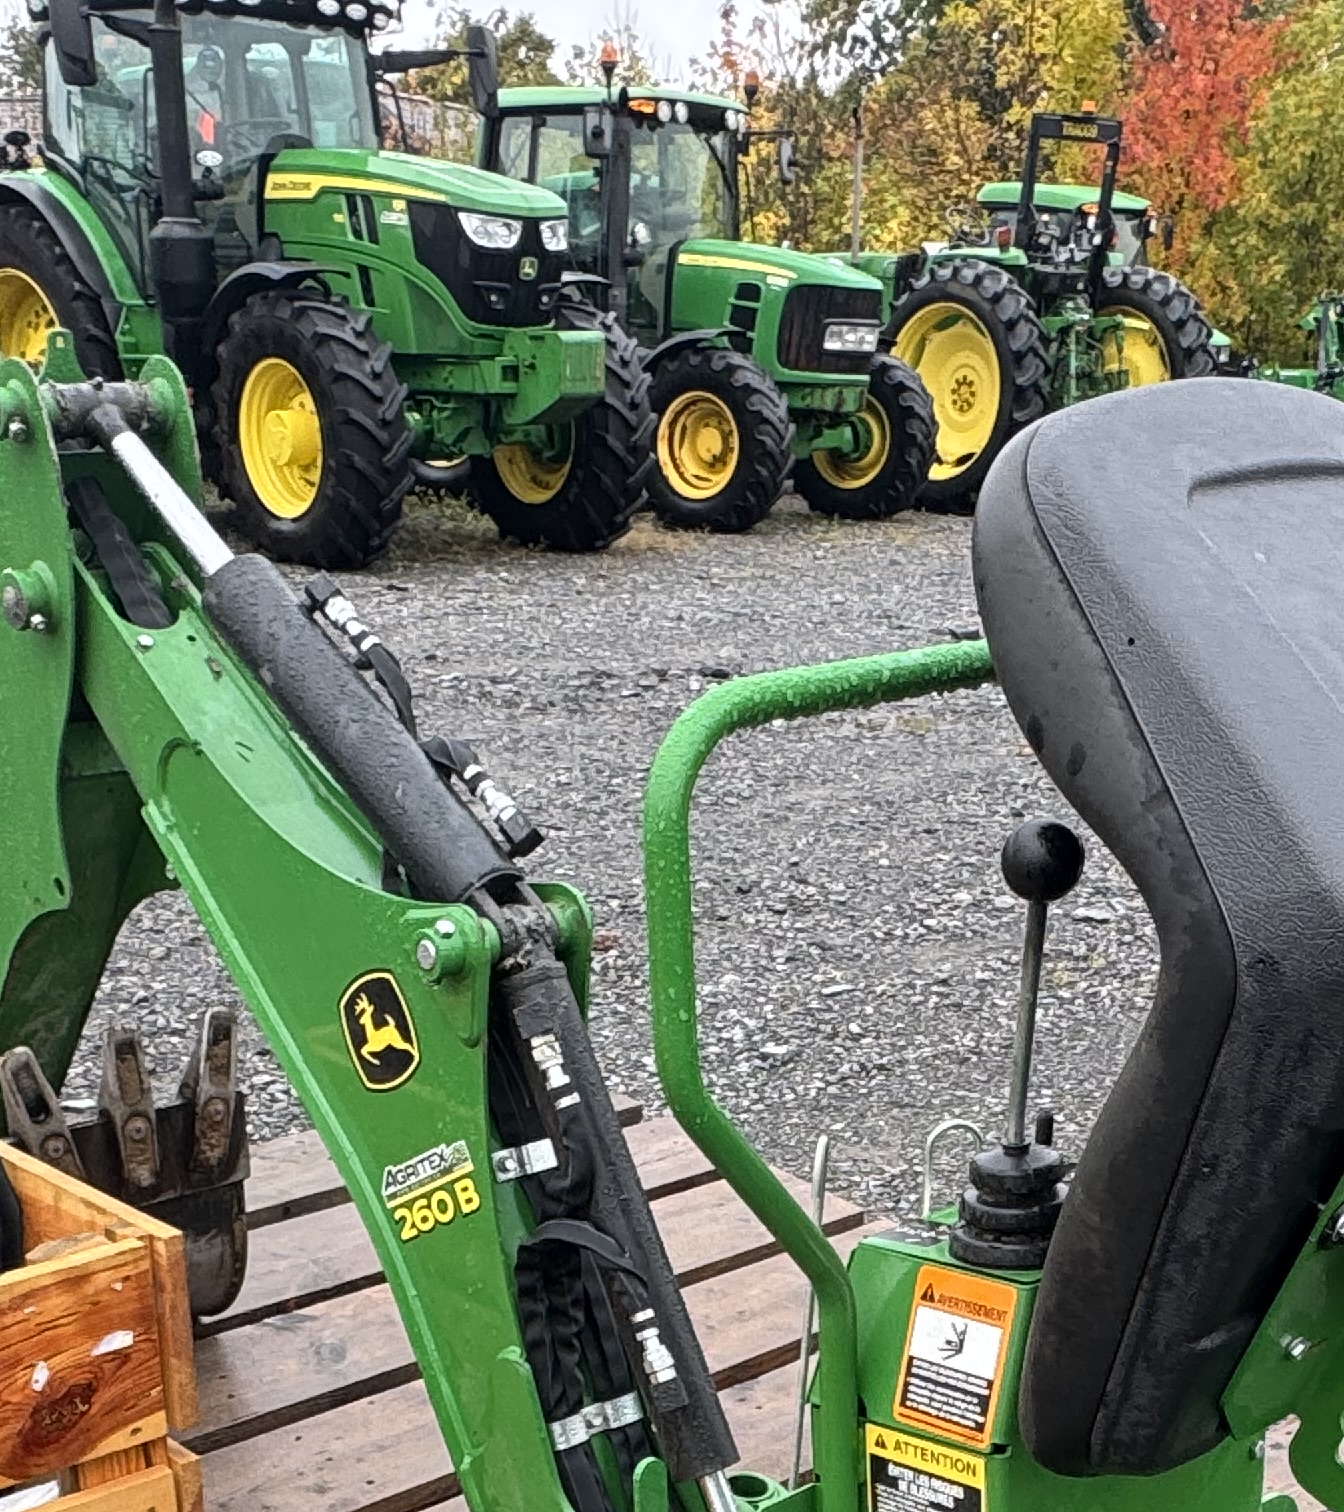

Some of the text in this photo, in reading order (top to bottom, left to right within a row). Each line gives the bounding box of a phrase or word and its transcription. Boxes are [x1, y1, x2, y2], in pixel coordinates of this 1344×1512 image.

[384, 1148, 447, 1192] AGRITEX
[394, 1190, 455, 1243] 260
[454, 1177, 481, 1217] B
[937, 1293, 1009, 1321] AVERTISSEMENT
[893, 1439, 977, 1478] ATTENTION
